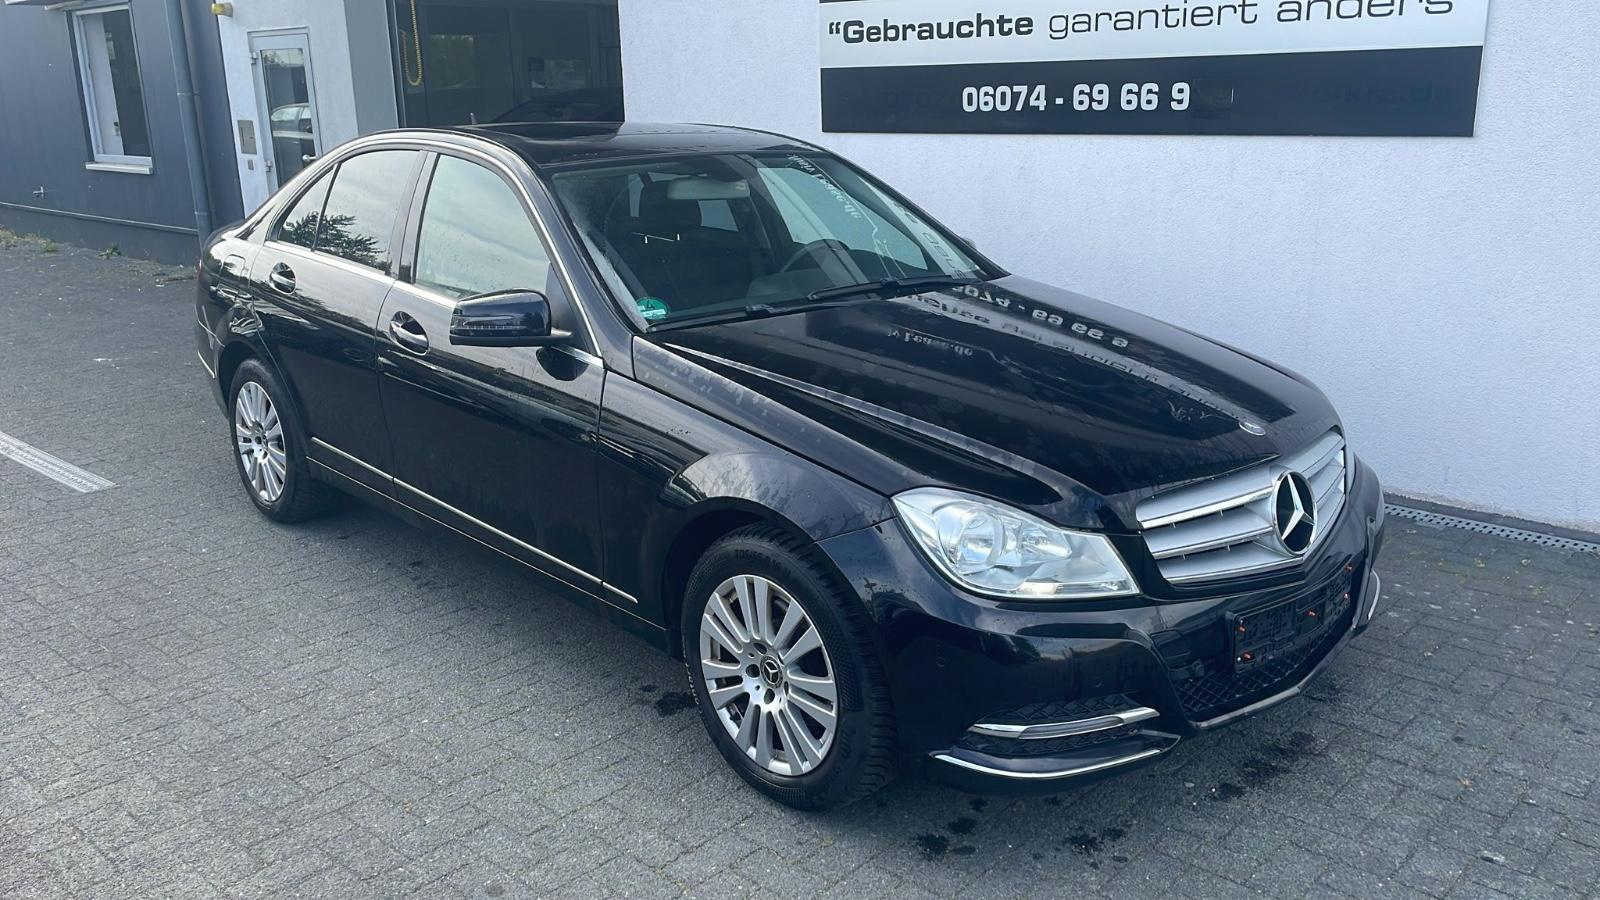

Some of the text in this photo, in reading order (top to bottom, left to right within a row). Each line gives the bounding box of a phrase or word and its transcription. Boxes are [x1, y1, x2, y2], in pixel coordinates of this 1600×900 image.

[1048, 2, 1258, 40] garantiert
[962, 84, 1047, 112] 06074
[1072, 83, 1110, 111] 69
[1120, 82, 1159, 111] 66
[1170, 82, 1191, 111] 9
